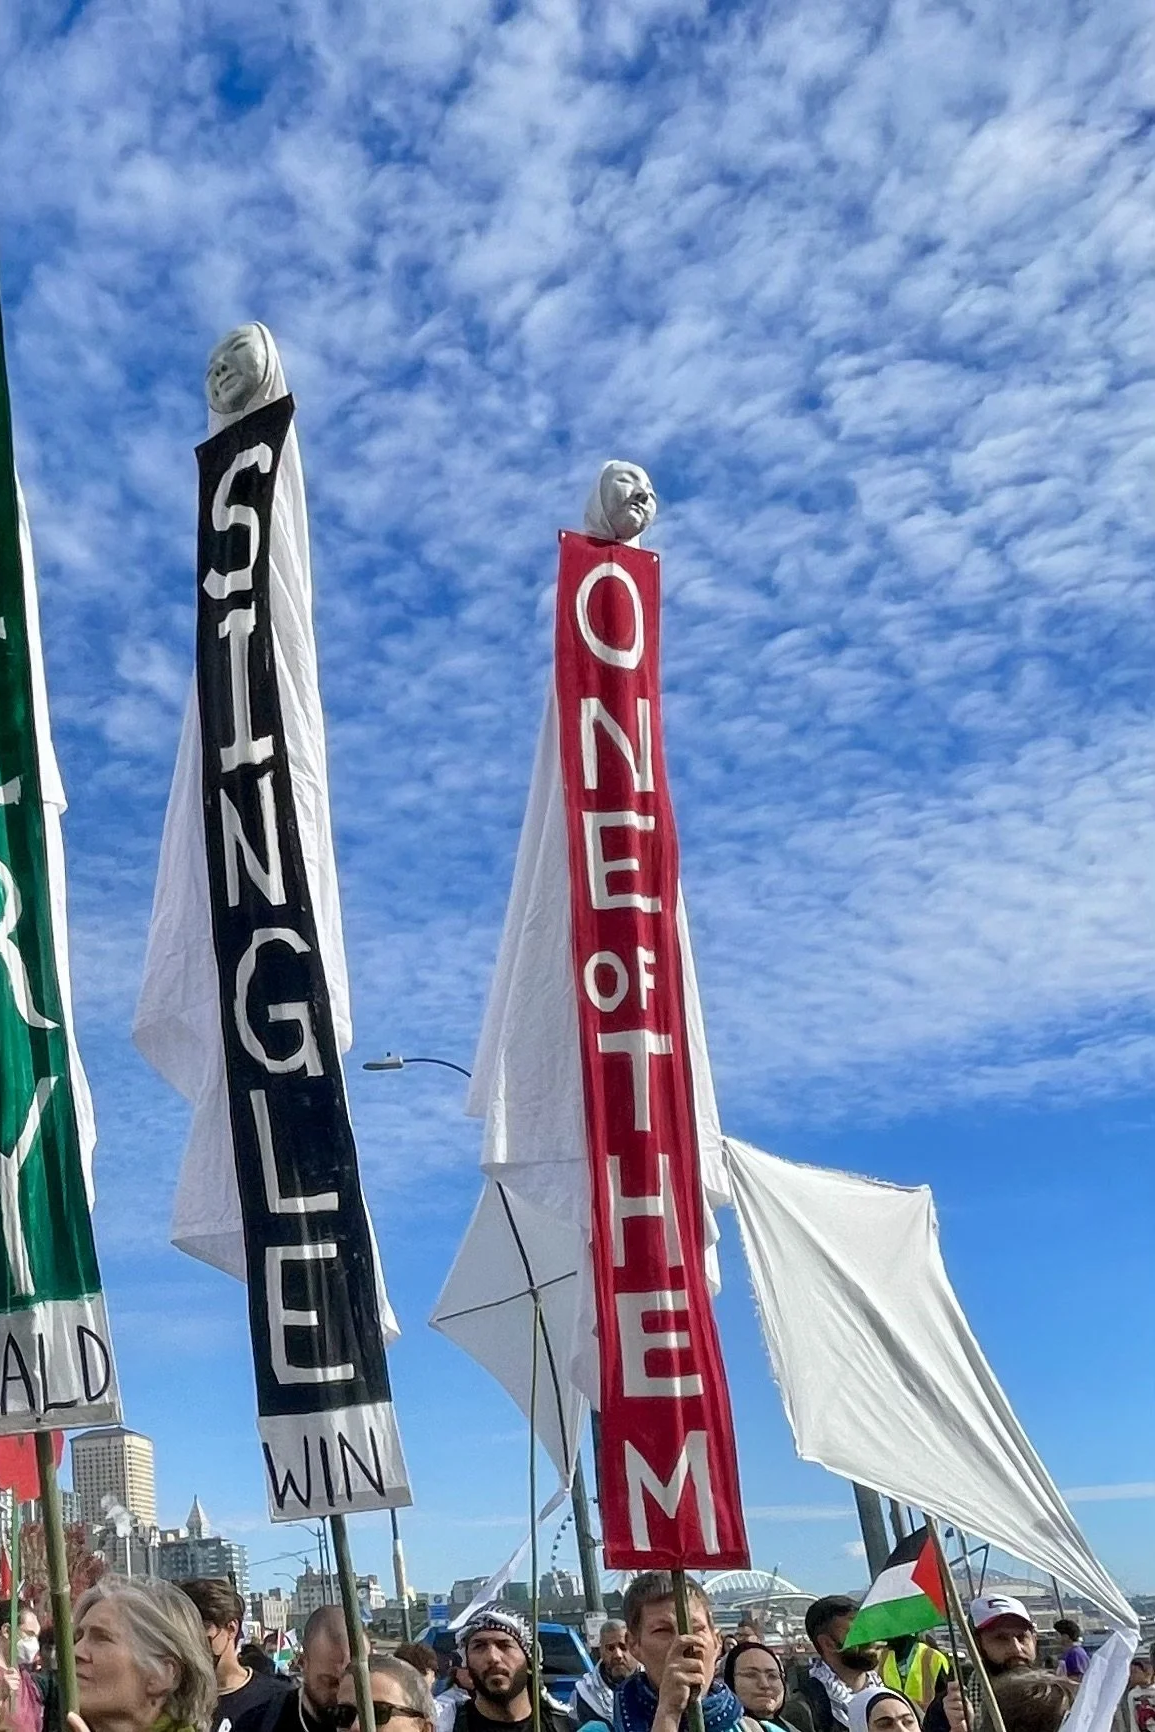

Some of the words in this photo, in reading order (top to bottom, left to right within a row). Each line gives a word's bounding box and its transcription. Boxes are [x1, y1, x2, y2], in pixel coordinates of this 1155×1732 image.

[202, 442, 354, 1385] SINGLE
[576, 561, 662, 912] ONE
[262, 1427, 386, 1510] WIN
[597, 1029, 721, 1555] THEM
